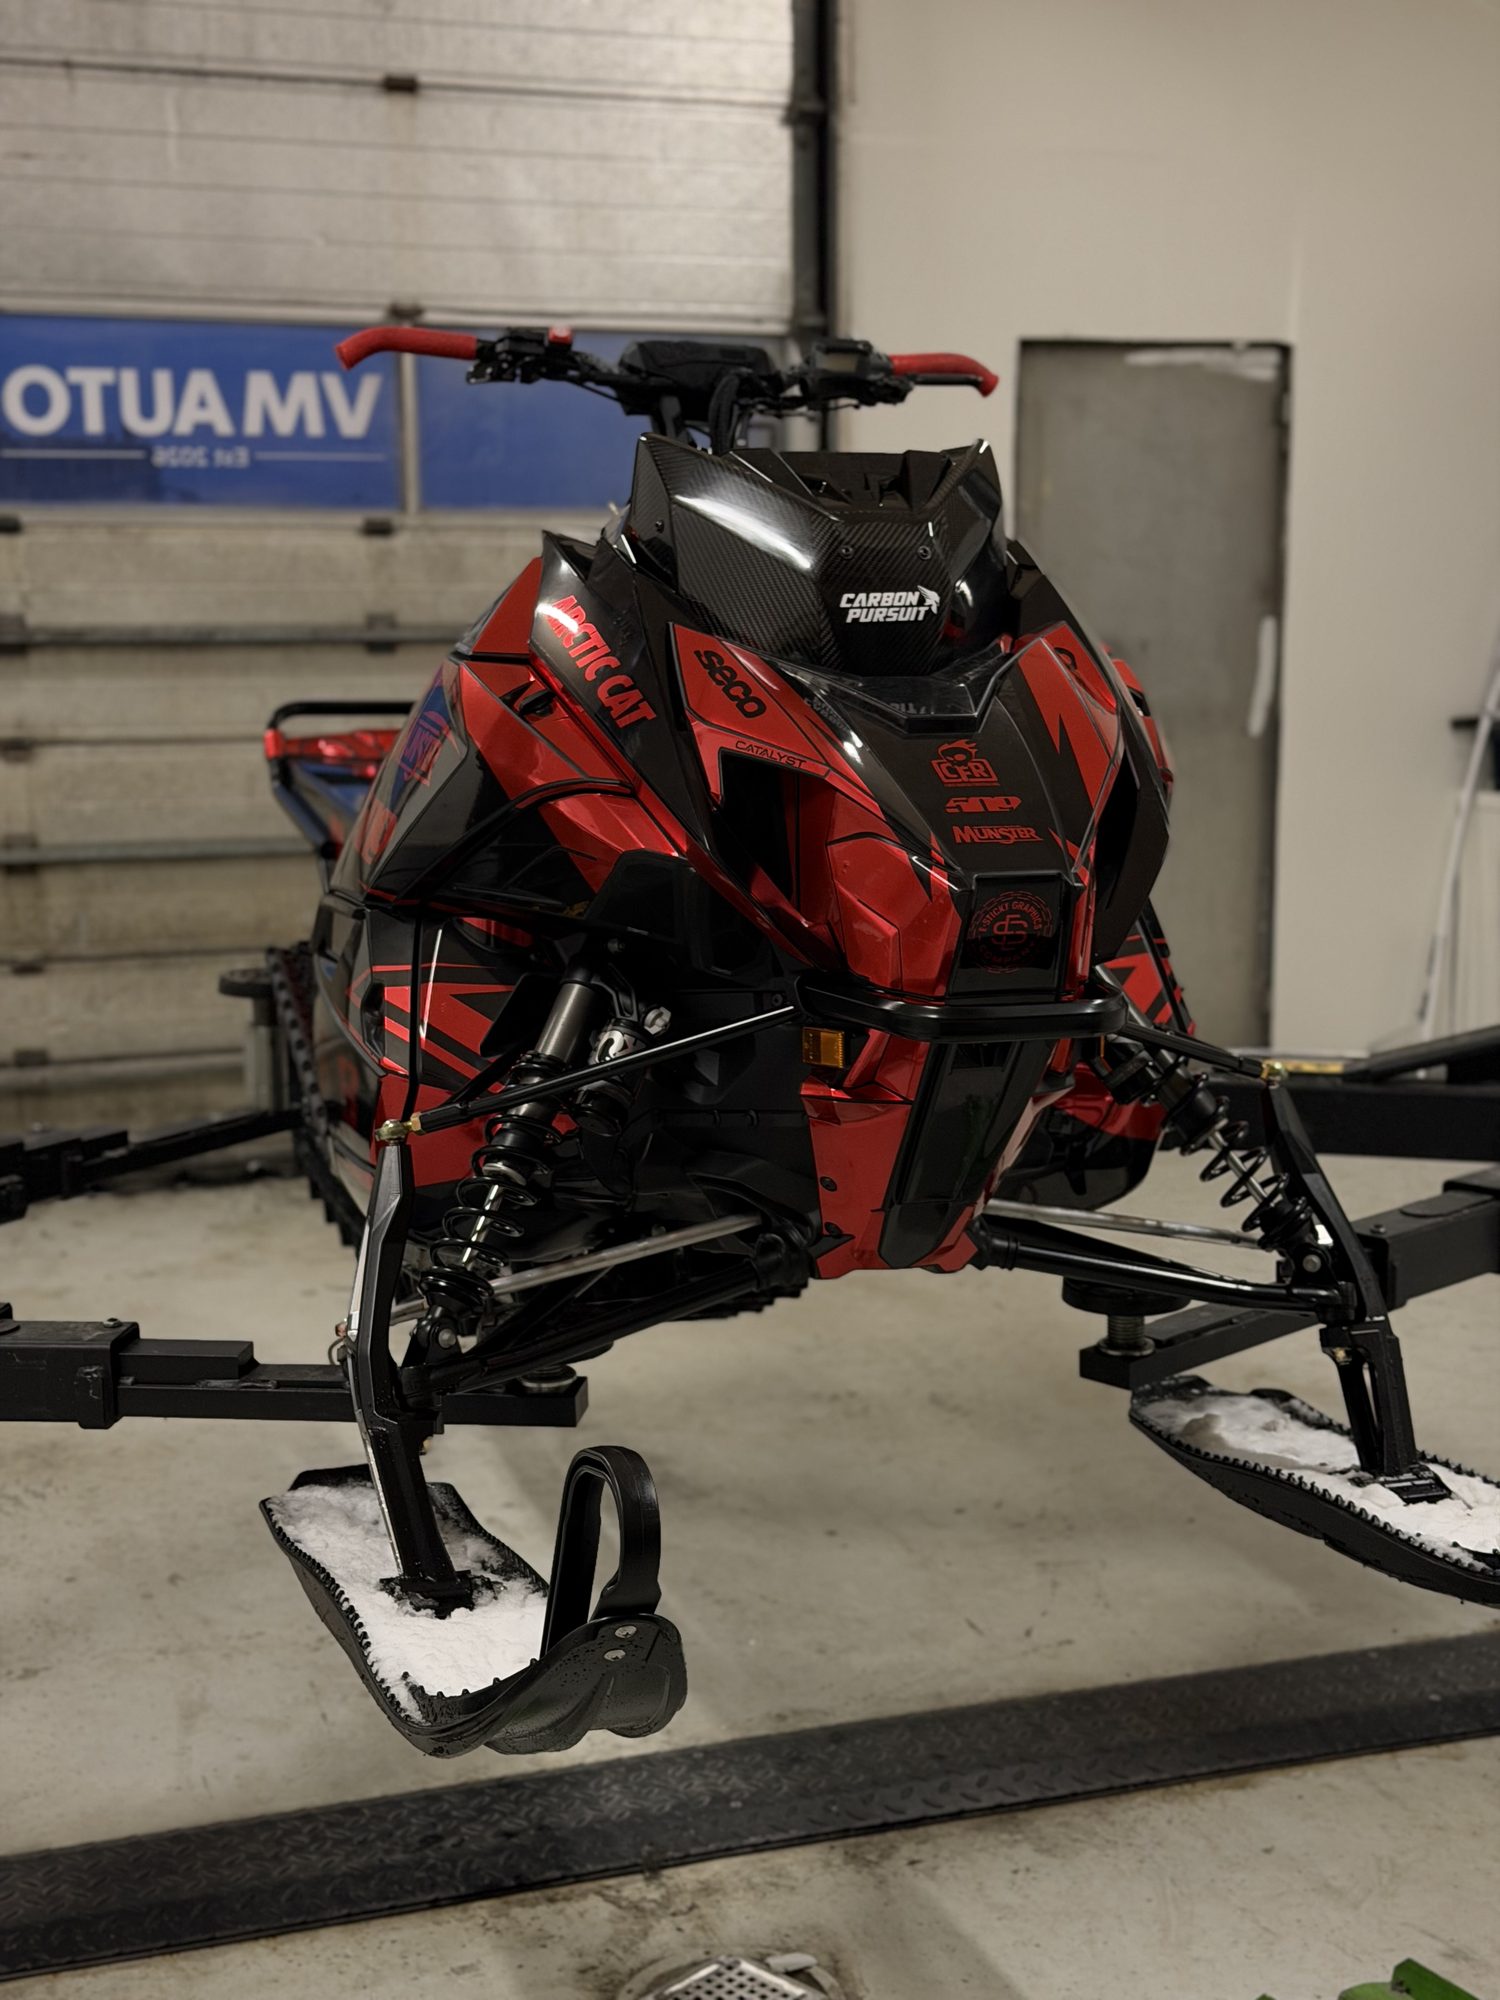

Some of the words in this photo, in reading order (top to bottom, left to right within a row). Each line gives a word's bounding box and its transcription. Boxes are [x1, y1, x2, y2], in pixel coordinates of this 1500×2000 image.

[839, 591, 920, 608] CARBON
[846, 606, 929, 623] PURSUIT
[546, 595, 621, 681] ARCTIC
[597, 674, 656, 728] CAT
[735, 740, 807, 769] CATALYST
[1012, 901, 1042, 931] GRAPHICS
